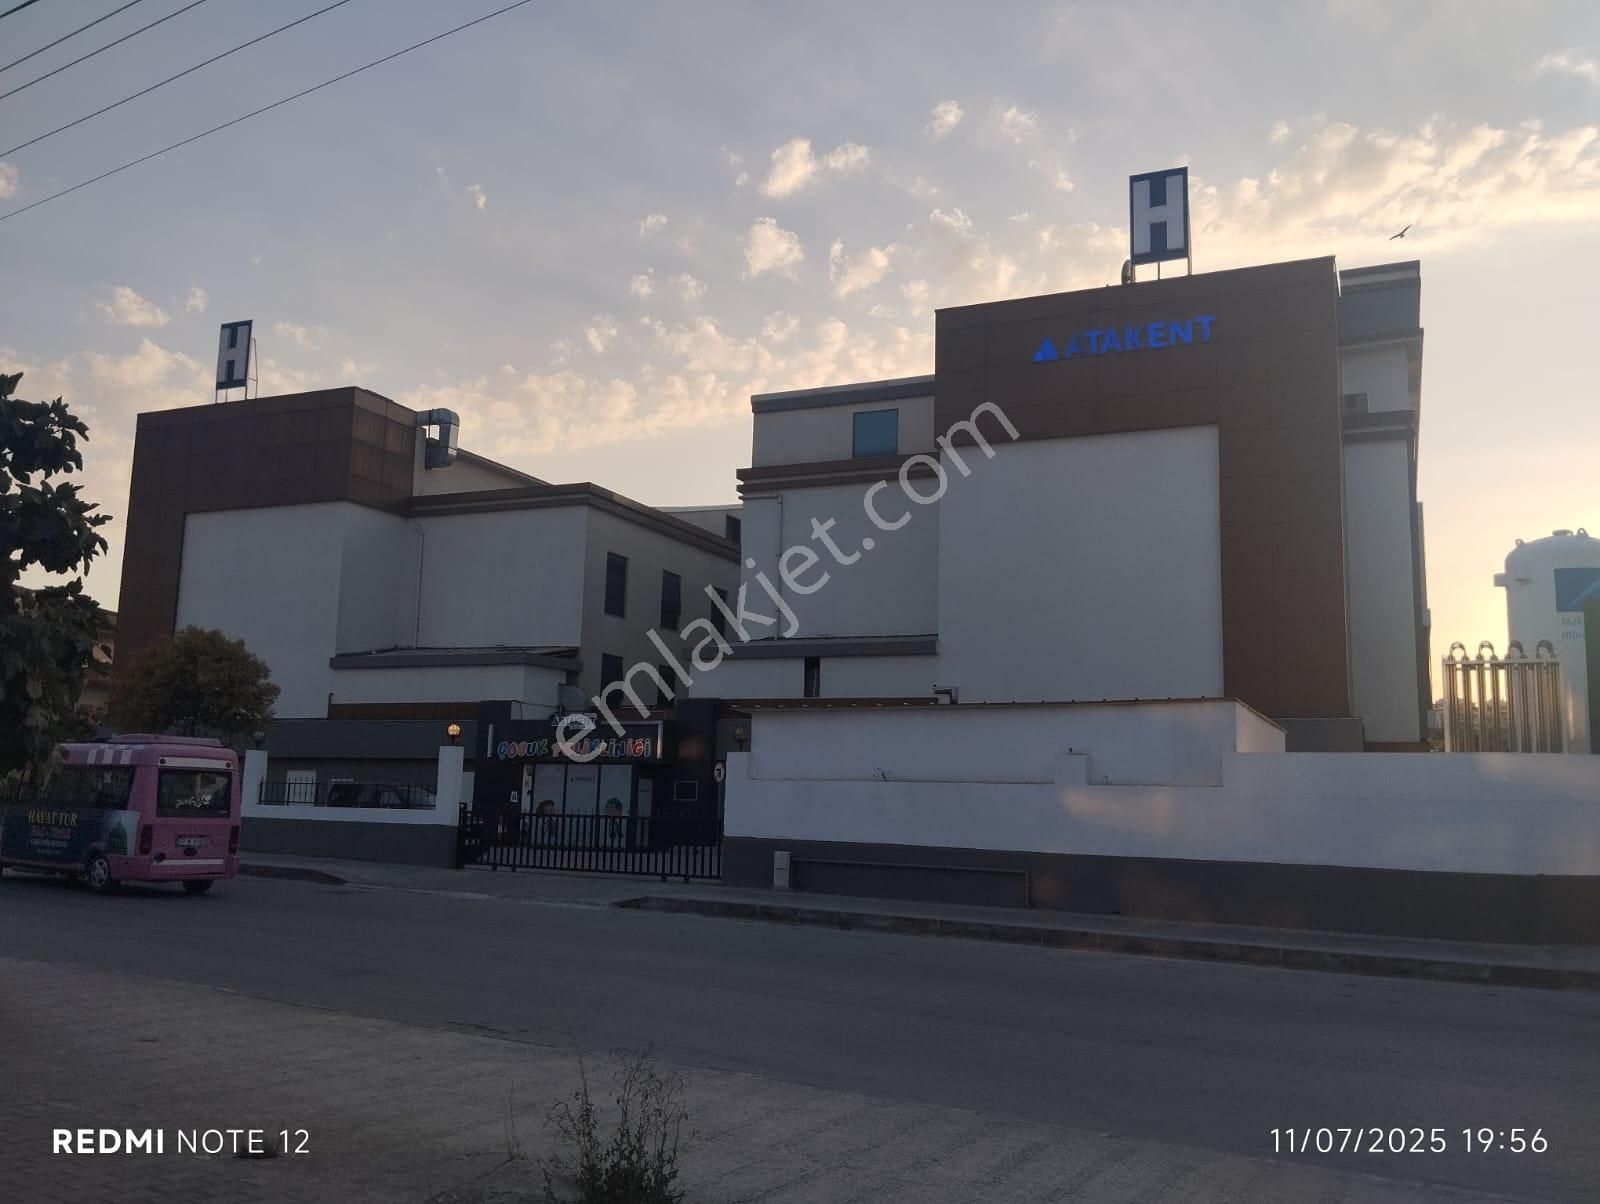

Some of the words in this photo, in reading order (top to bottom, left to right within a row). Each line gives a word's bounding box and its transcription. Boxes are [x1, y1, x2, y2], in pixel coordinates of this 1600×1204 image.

[1133, 174, 1185, 255] H
[216, 325, 250, 383] H
[1064, 315, 1217, 361] ATAKENT
[498, 739, 549, 761] ÇOCUK
[59, 812, 78, 827] TUR
